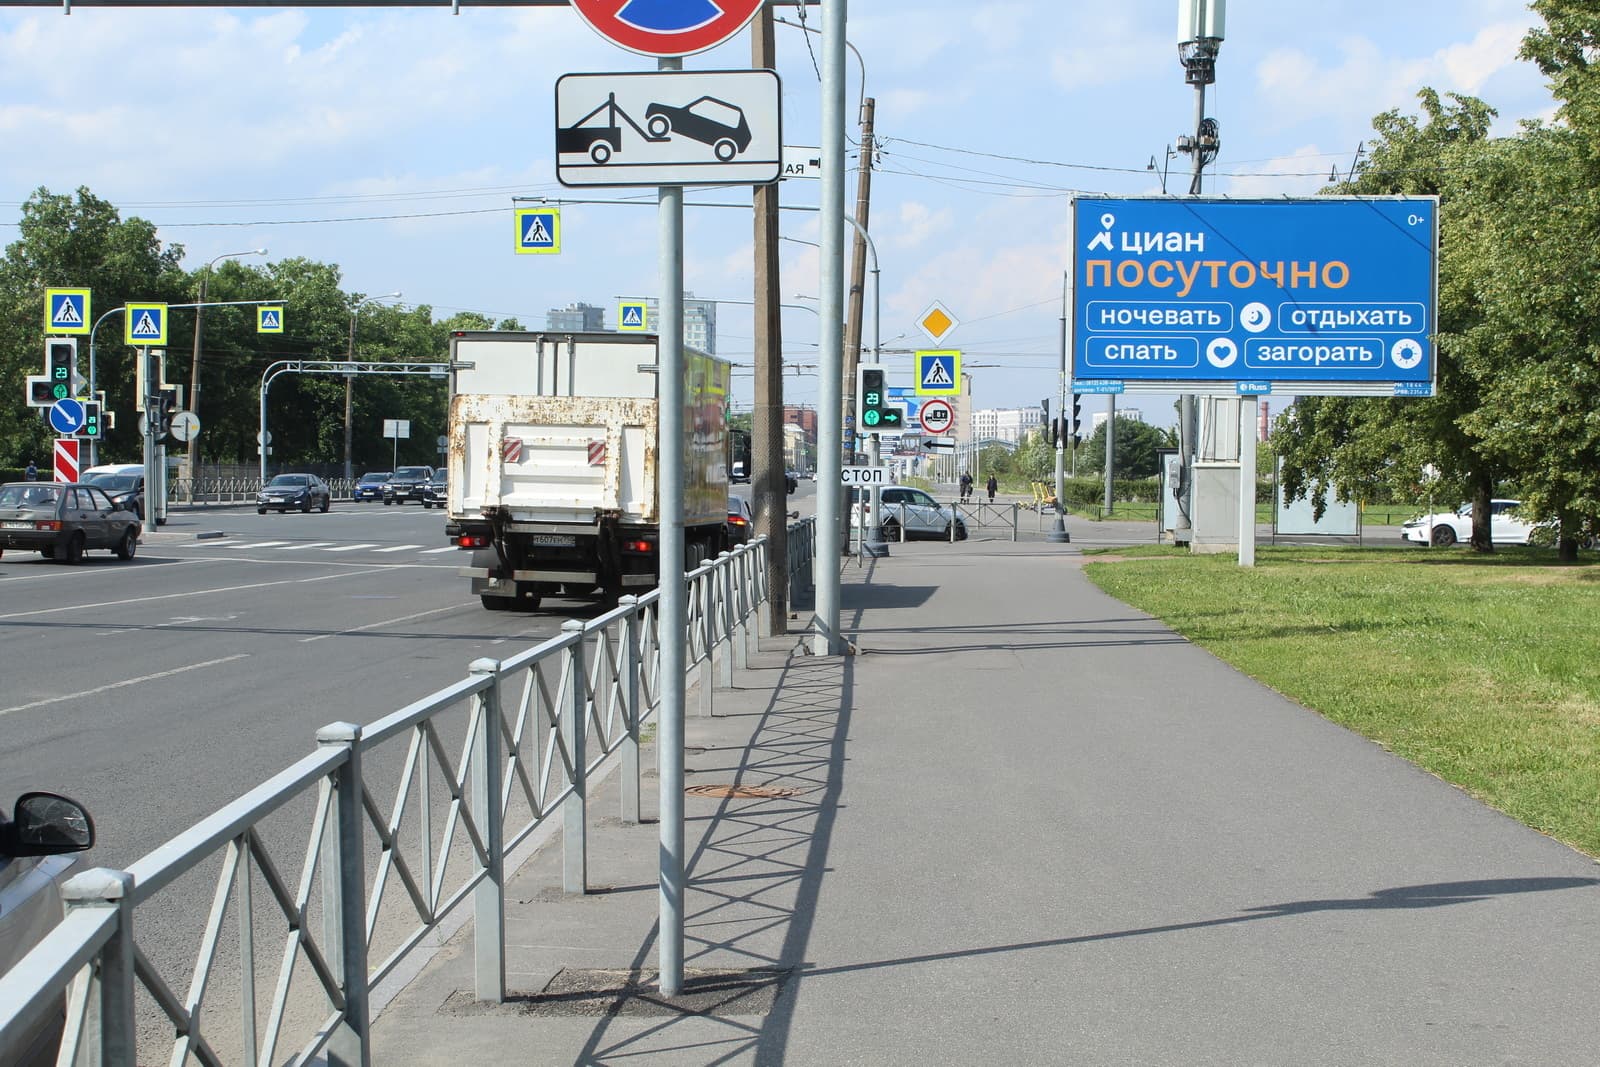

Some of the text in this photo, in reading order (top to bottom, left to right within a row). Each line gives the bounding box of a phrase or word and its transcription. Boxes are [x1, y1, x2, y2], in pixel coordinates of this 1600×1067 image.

[785, 163, 804, 174] АЯ
[1407, 214, 1425, 226] 0+
[1121, 231, 1204, 255] циан
[1086, 259, 1350, 298] посуточно
[1101, 308, 1222, 326] ночевать
[1291, 308, 1412, 329] отдыхать
[1104, 344, 1178, 360] спать
[1257, 345, 1373, 366] загорать
[55, 367, 68, 379] 23
[841, 469, 882, 483] СТОП
